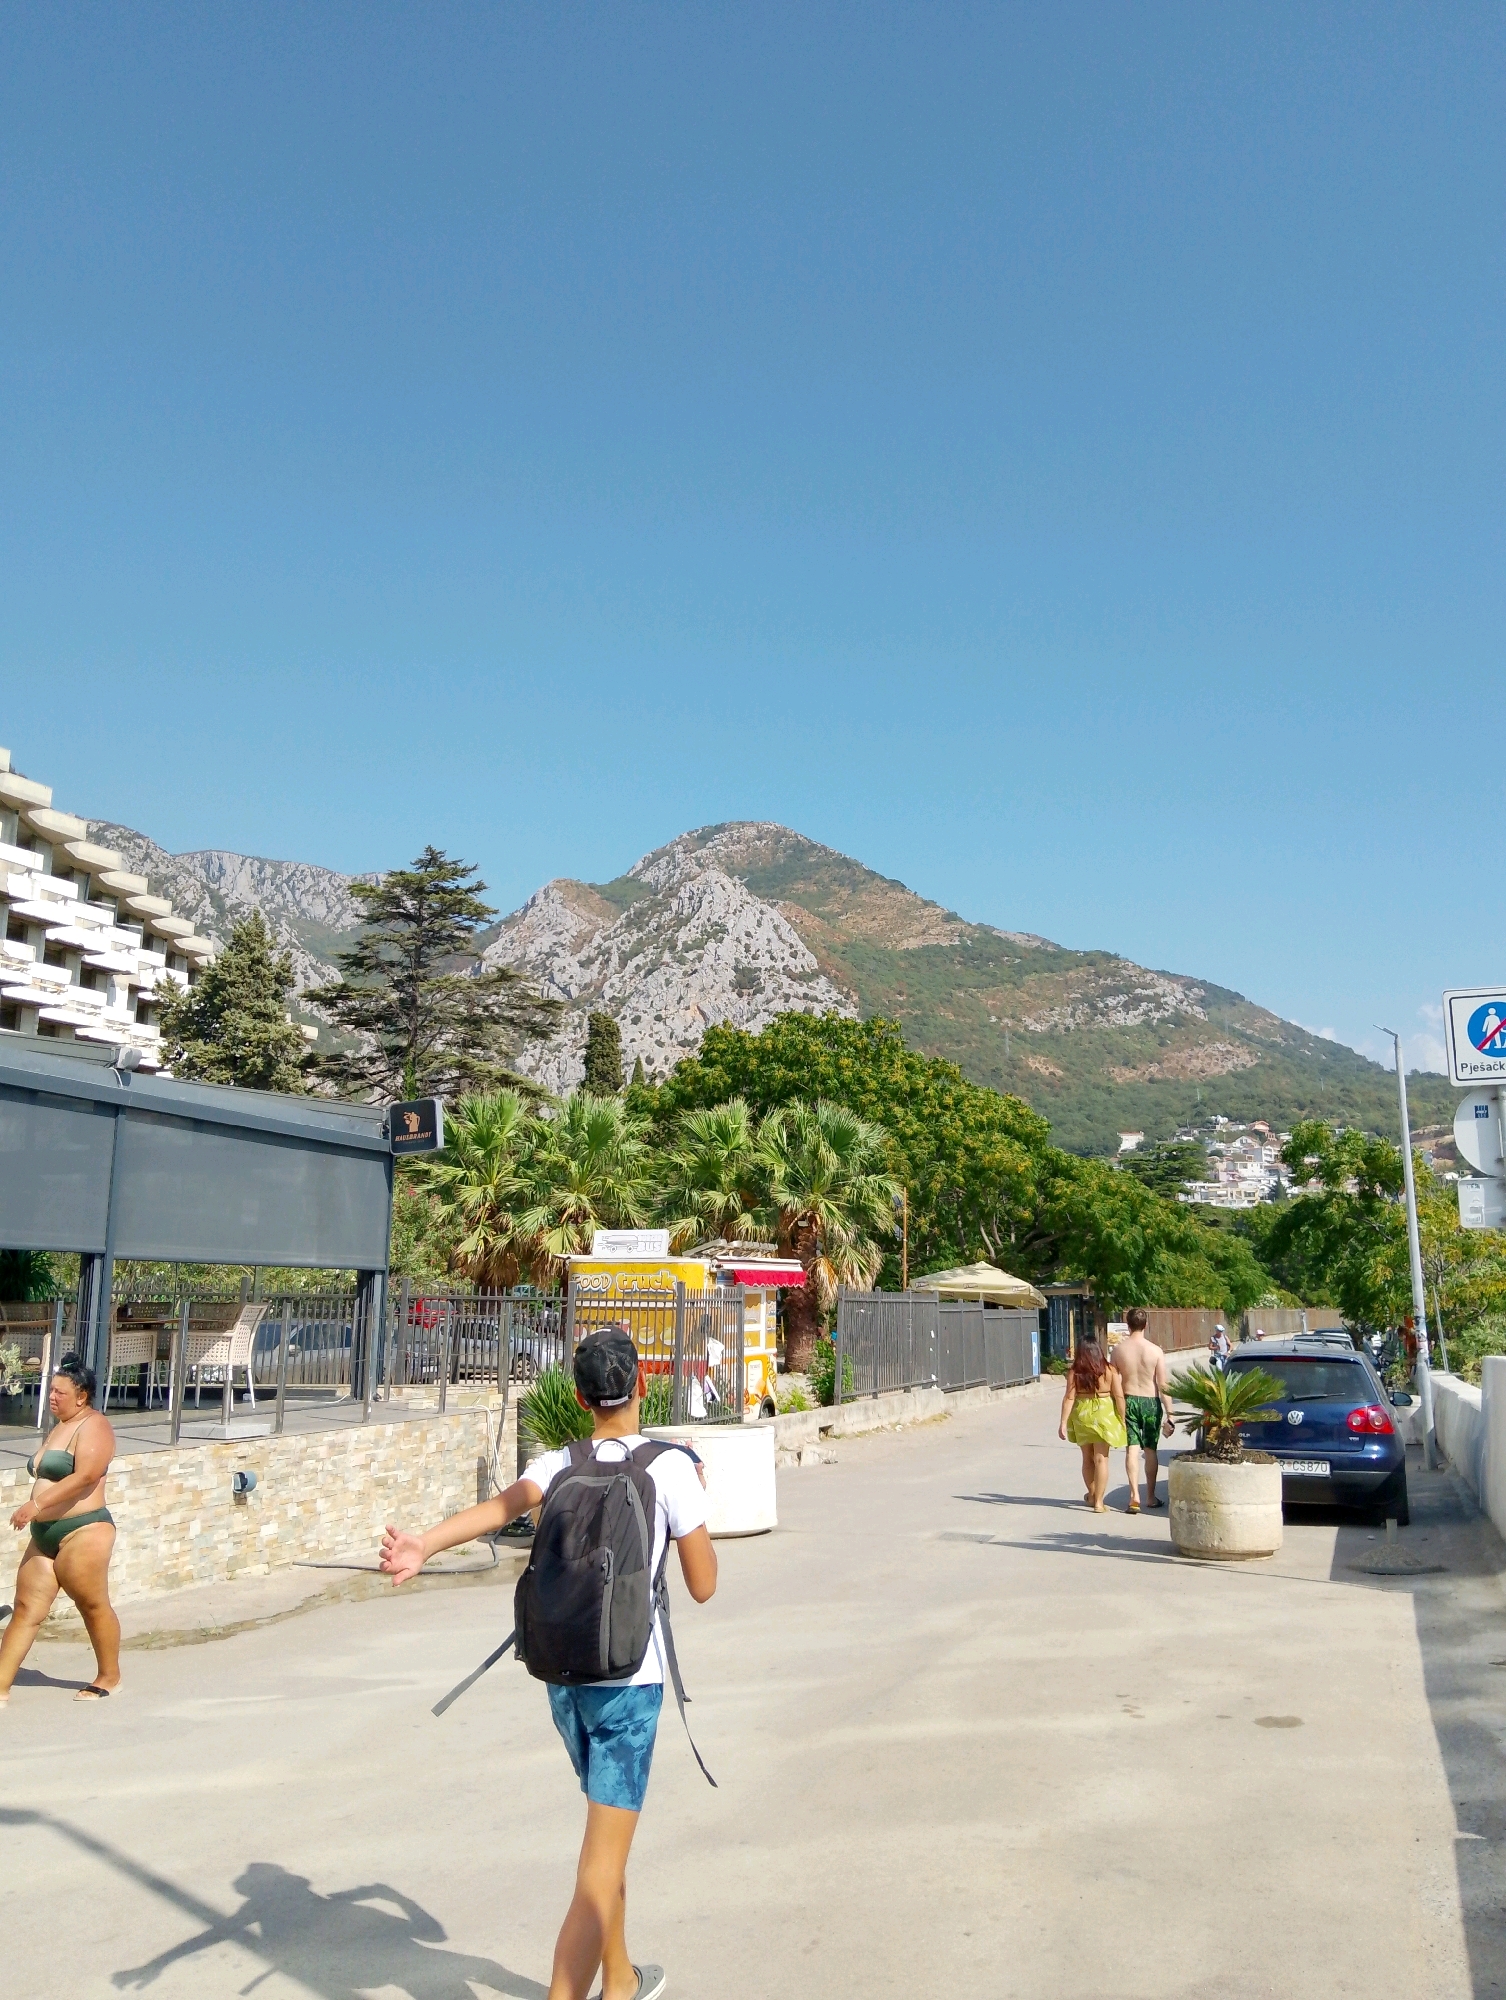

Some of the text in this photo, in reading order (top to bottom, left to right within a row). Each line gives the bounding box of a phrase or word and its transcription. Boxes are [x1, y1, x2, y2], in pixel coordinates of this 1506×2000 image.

[395, 1131, 432, 1142] HAUSBRANDT
[616, 1270, 678, 1292] truck
[1292, 1460, 1328, 1473] CS870
